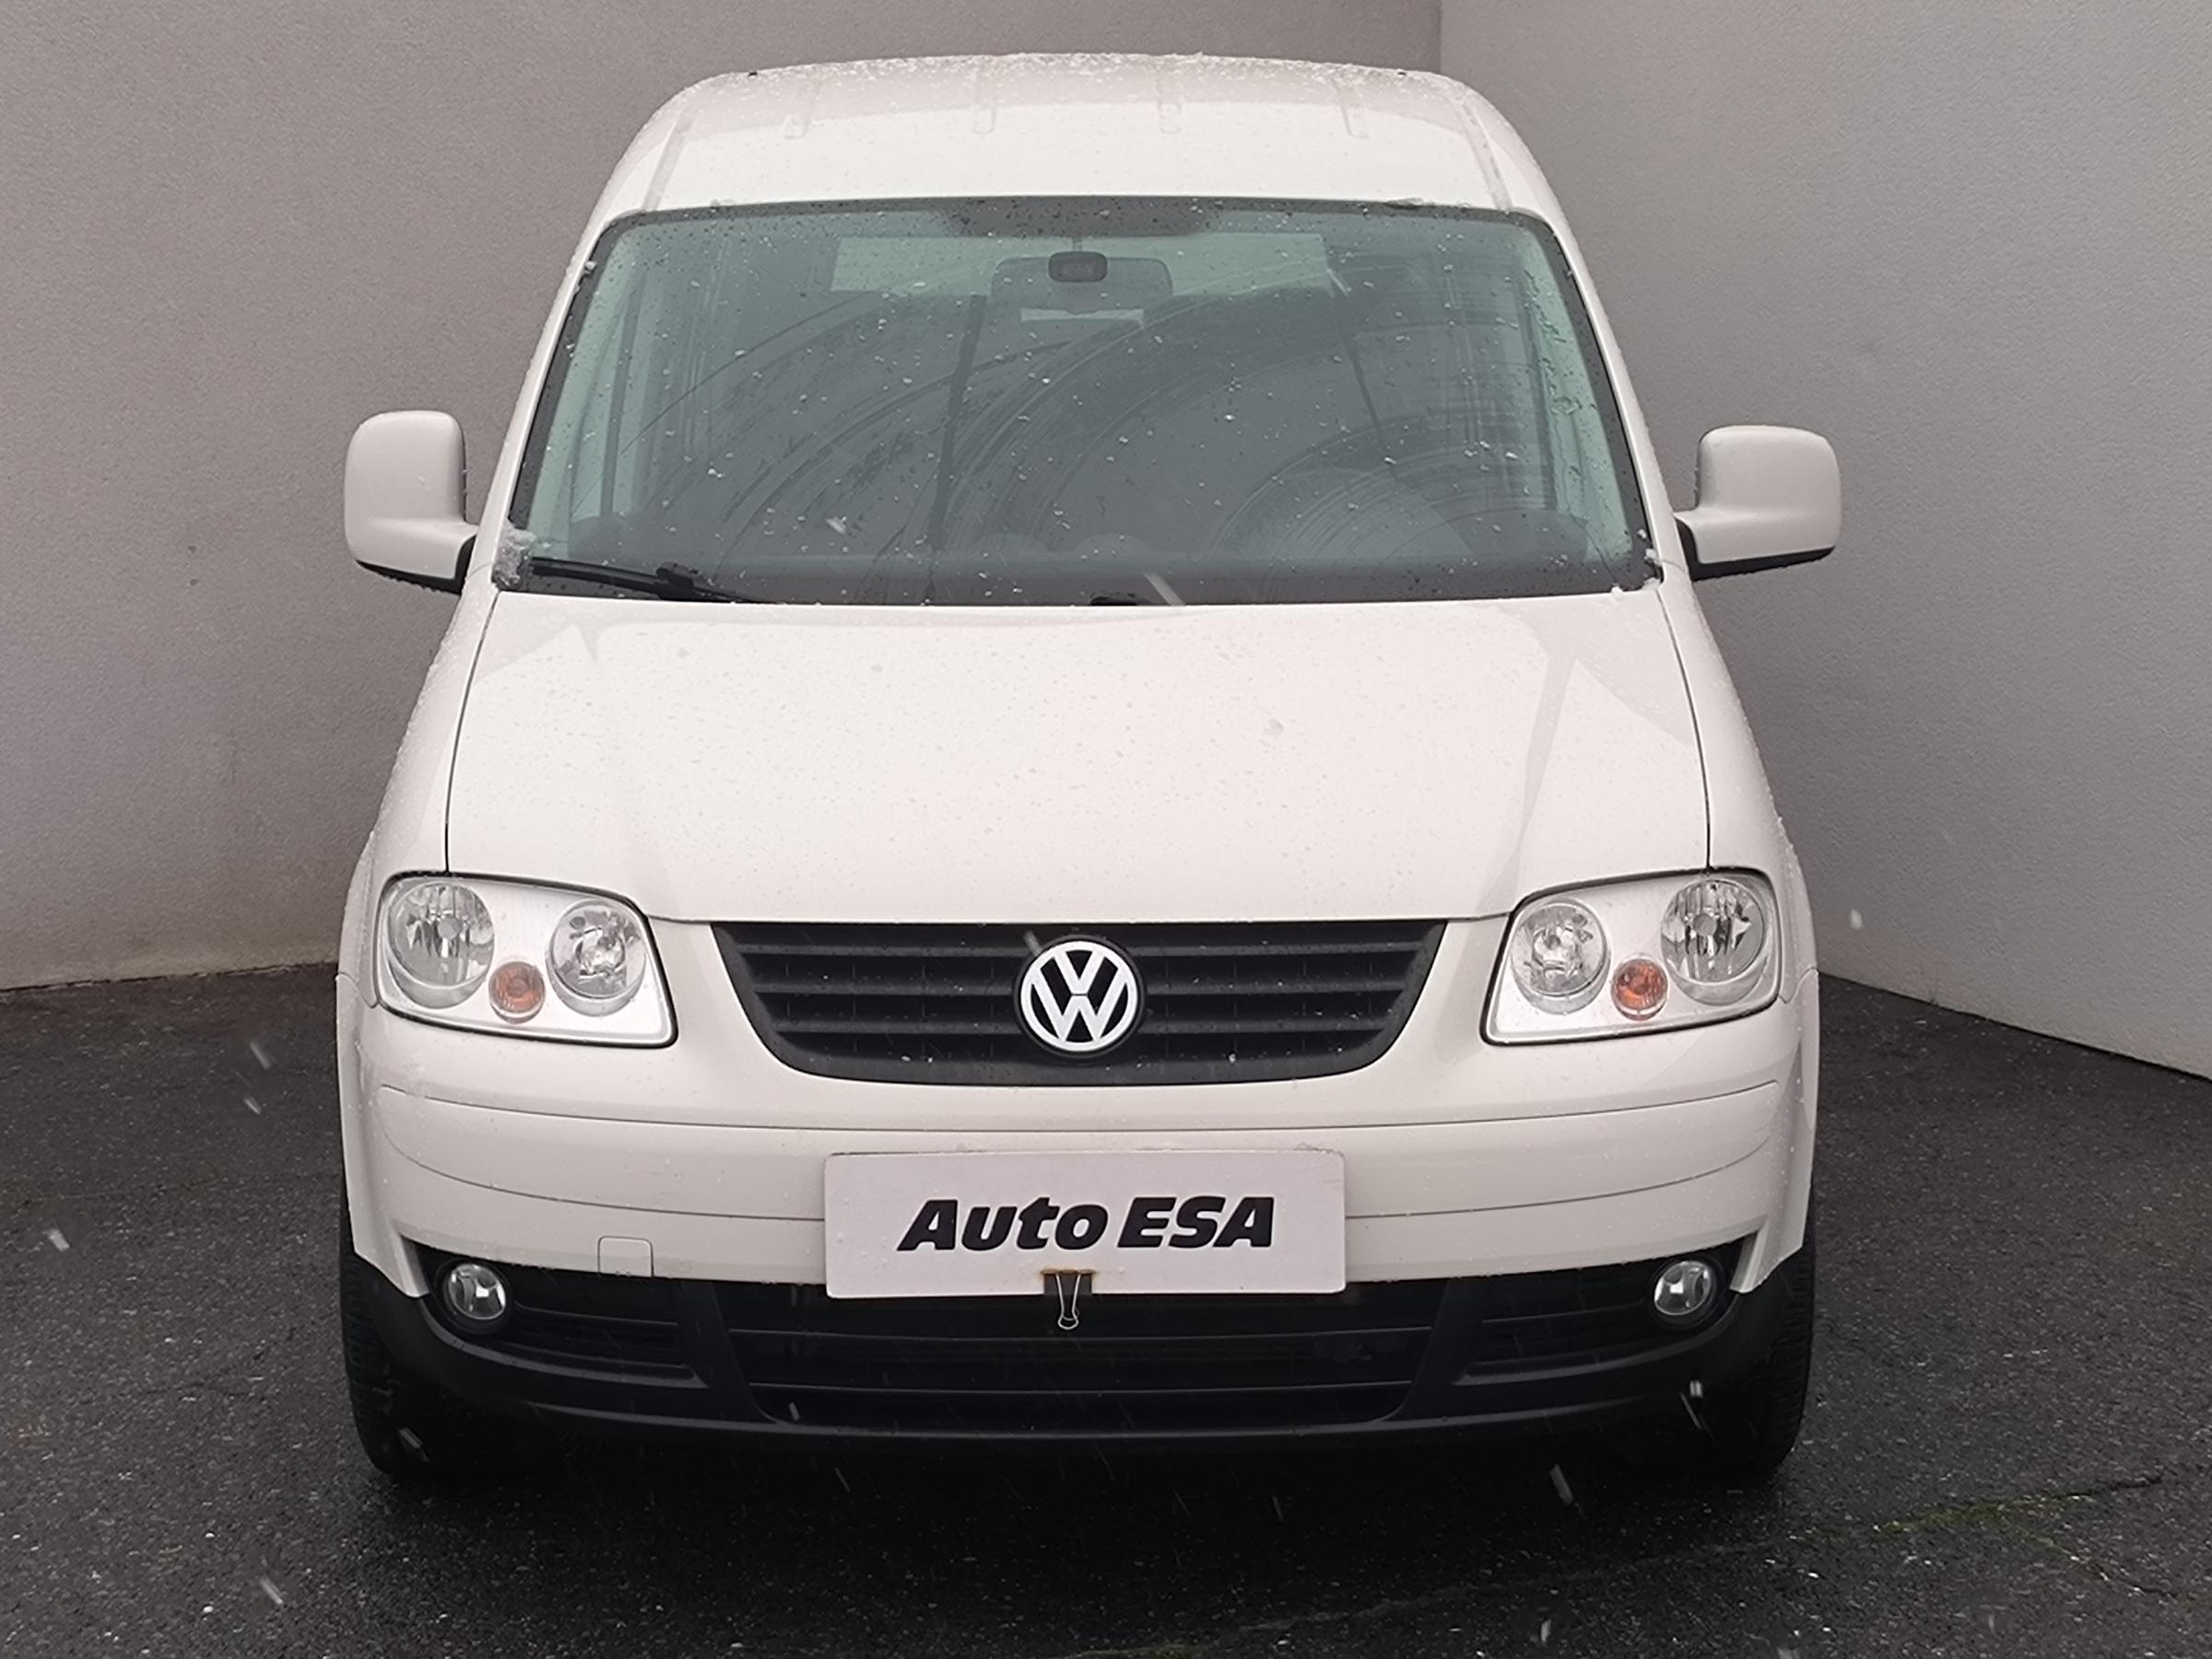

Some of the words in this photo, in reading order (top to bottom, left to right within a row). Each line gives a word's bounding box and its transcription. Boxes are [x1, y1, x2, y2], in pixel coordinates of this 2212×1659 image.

[1022, 943, 1135, 1050] VW
[896, 1196, 1109, 1252] Auto
[1117, 1195, 1275, 1249] ESA
